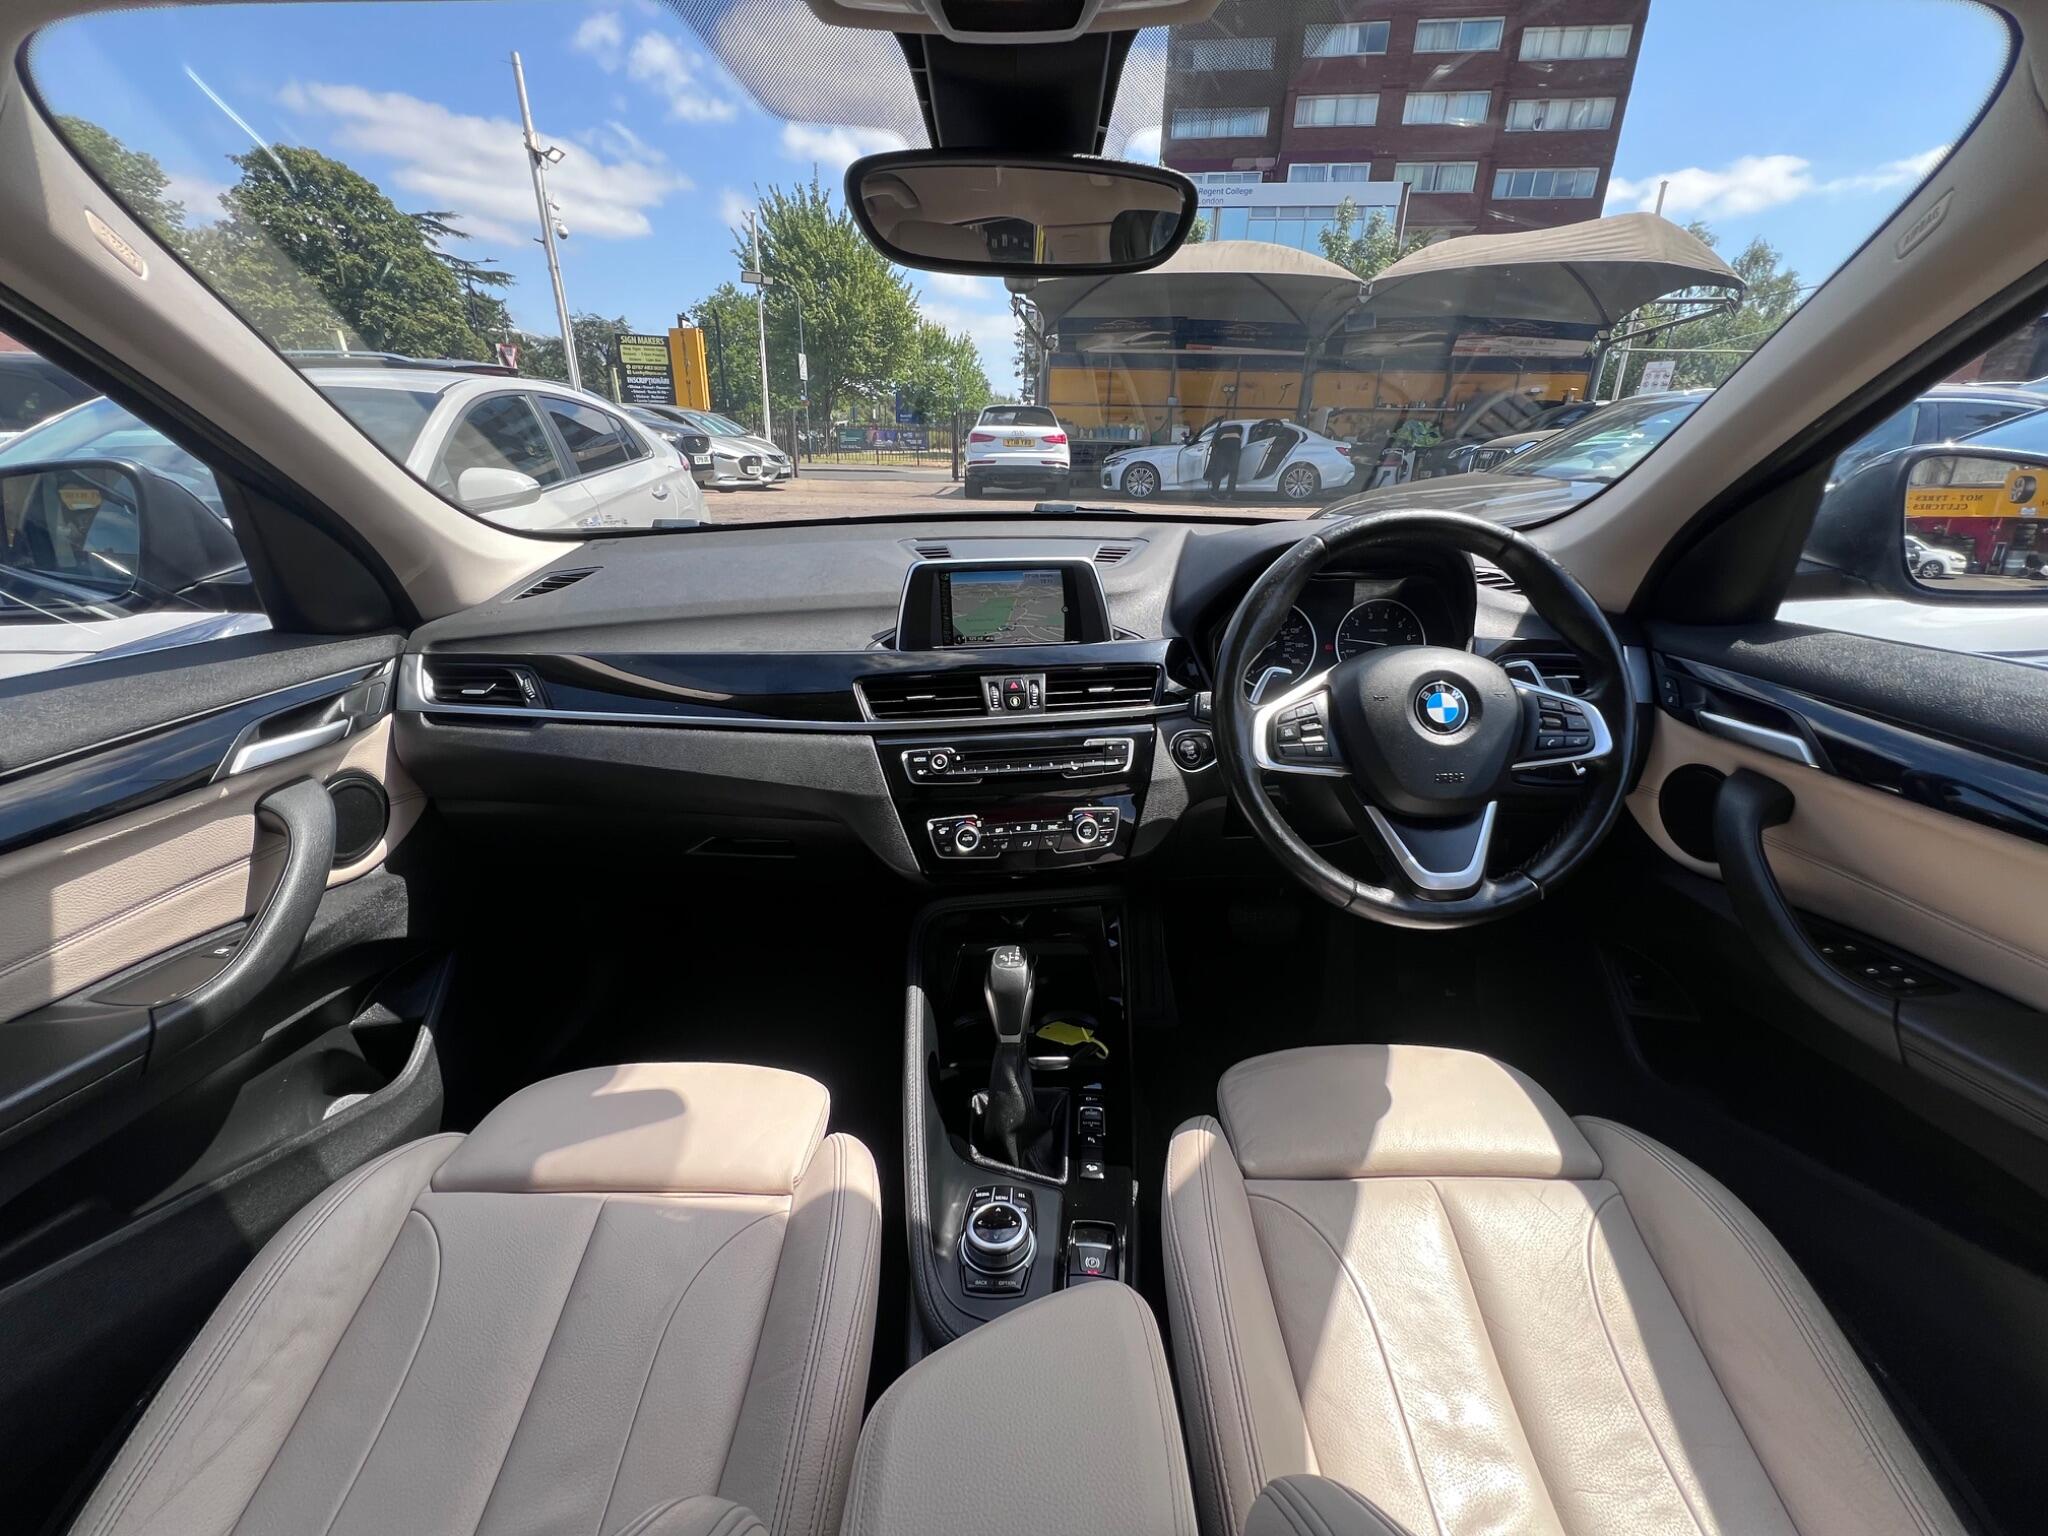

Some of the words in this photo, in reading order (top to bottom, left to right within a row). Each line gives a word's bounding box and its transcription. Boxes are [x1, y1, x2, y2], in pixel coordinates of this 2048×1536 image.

[1198, 187, 1224, 197] Regent
[1225, 187, 1253, 197] College
[620, 335, 637, 345] SIGN
[637, 336, 665, 345] MAKERS
